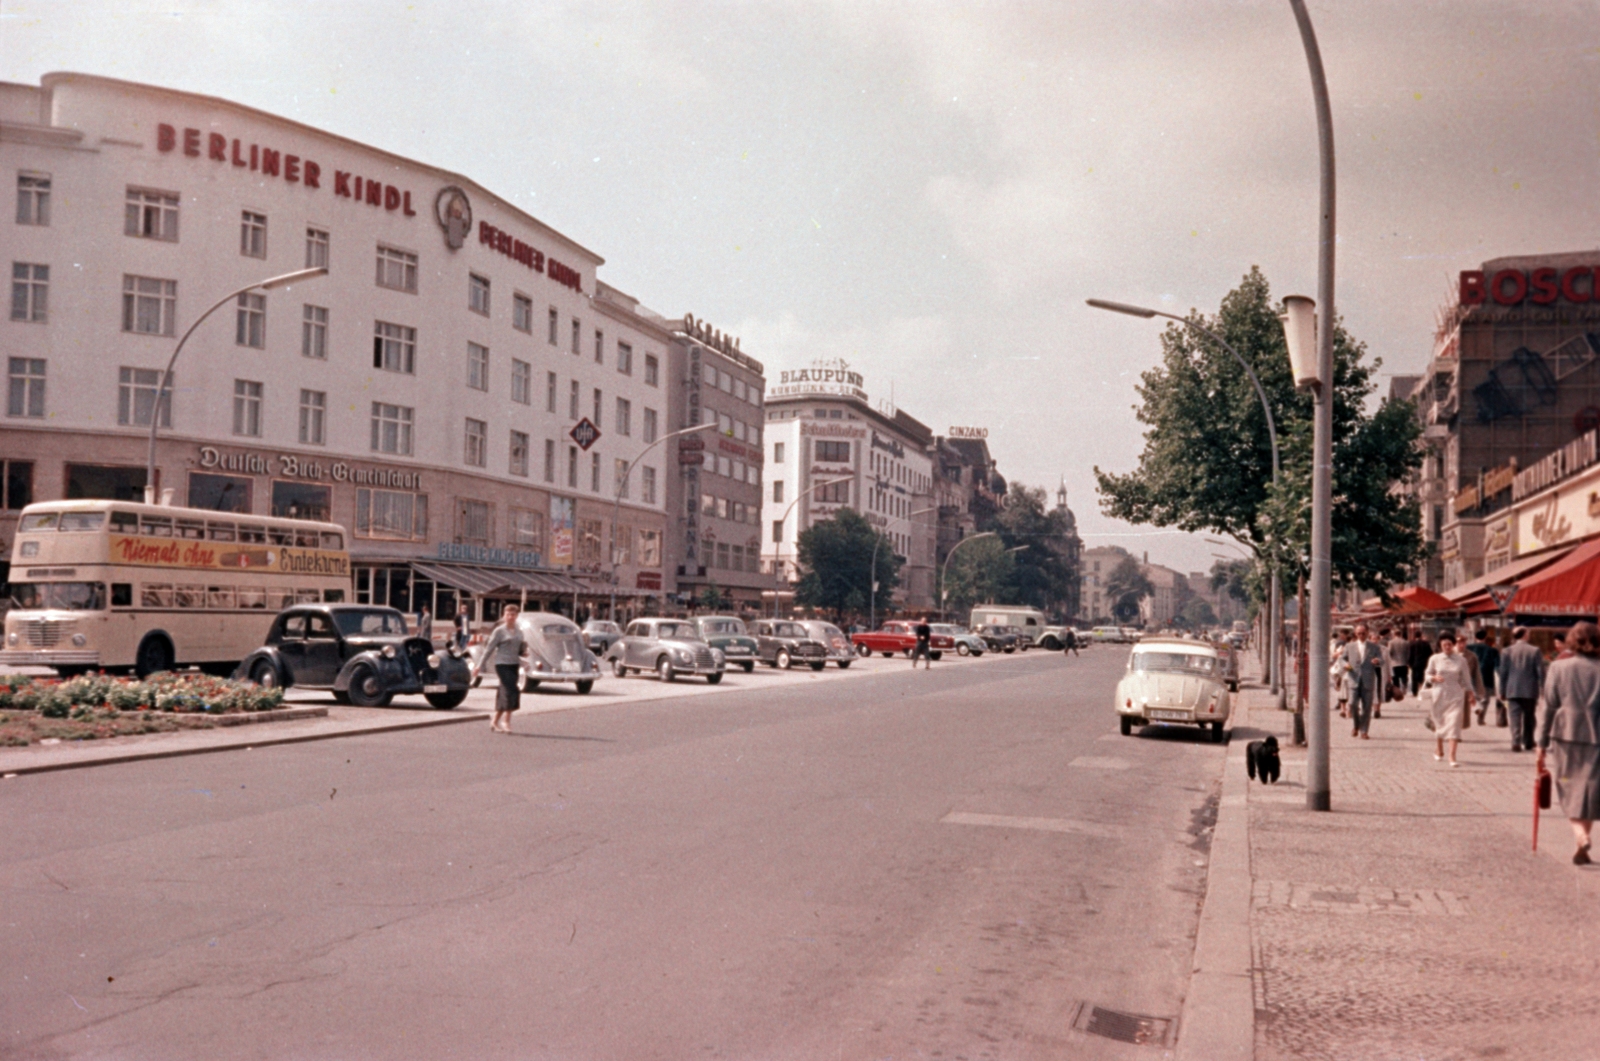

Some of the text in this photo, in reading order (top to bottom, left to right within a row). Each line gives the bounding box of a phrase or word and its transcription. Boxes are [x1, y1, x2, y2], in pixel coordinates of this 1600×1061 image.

[157, 123, 416, 217] BERLINER KINDL
[479, 220, 545, 274] BERLINER
[1459, 264, 1600, 306] BOSC
[949, 426, 988, 438] CINZANO
[200, 446, 422, 490] Deutsche Buch-Gemeinschaft
[117, 538, 348, 574] Niemals ohne Erntekrone
